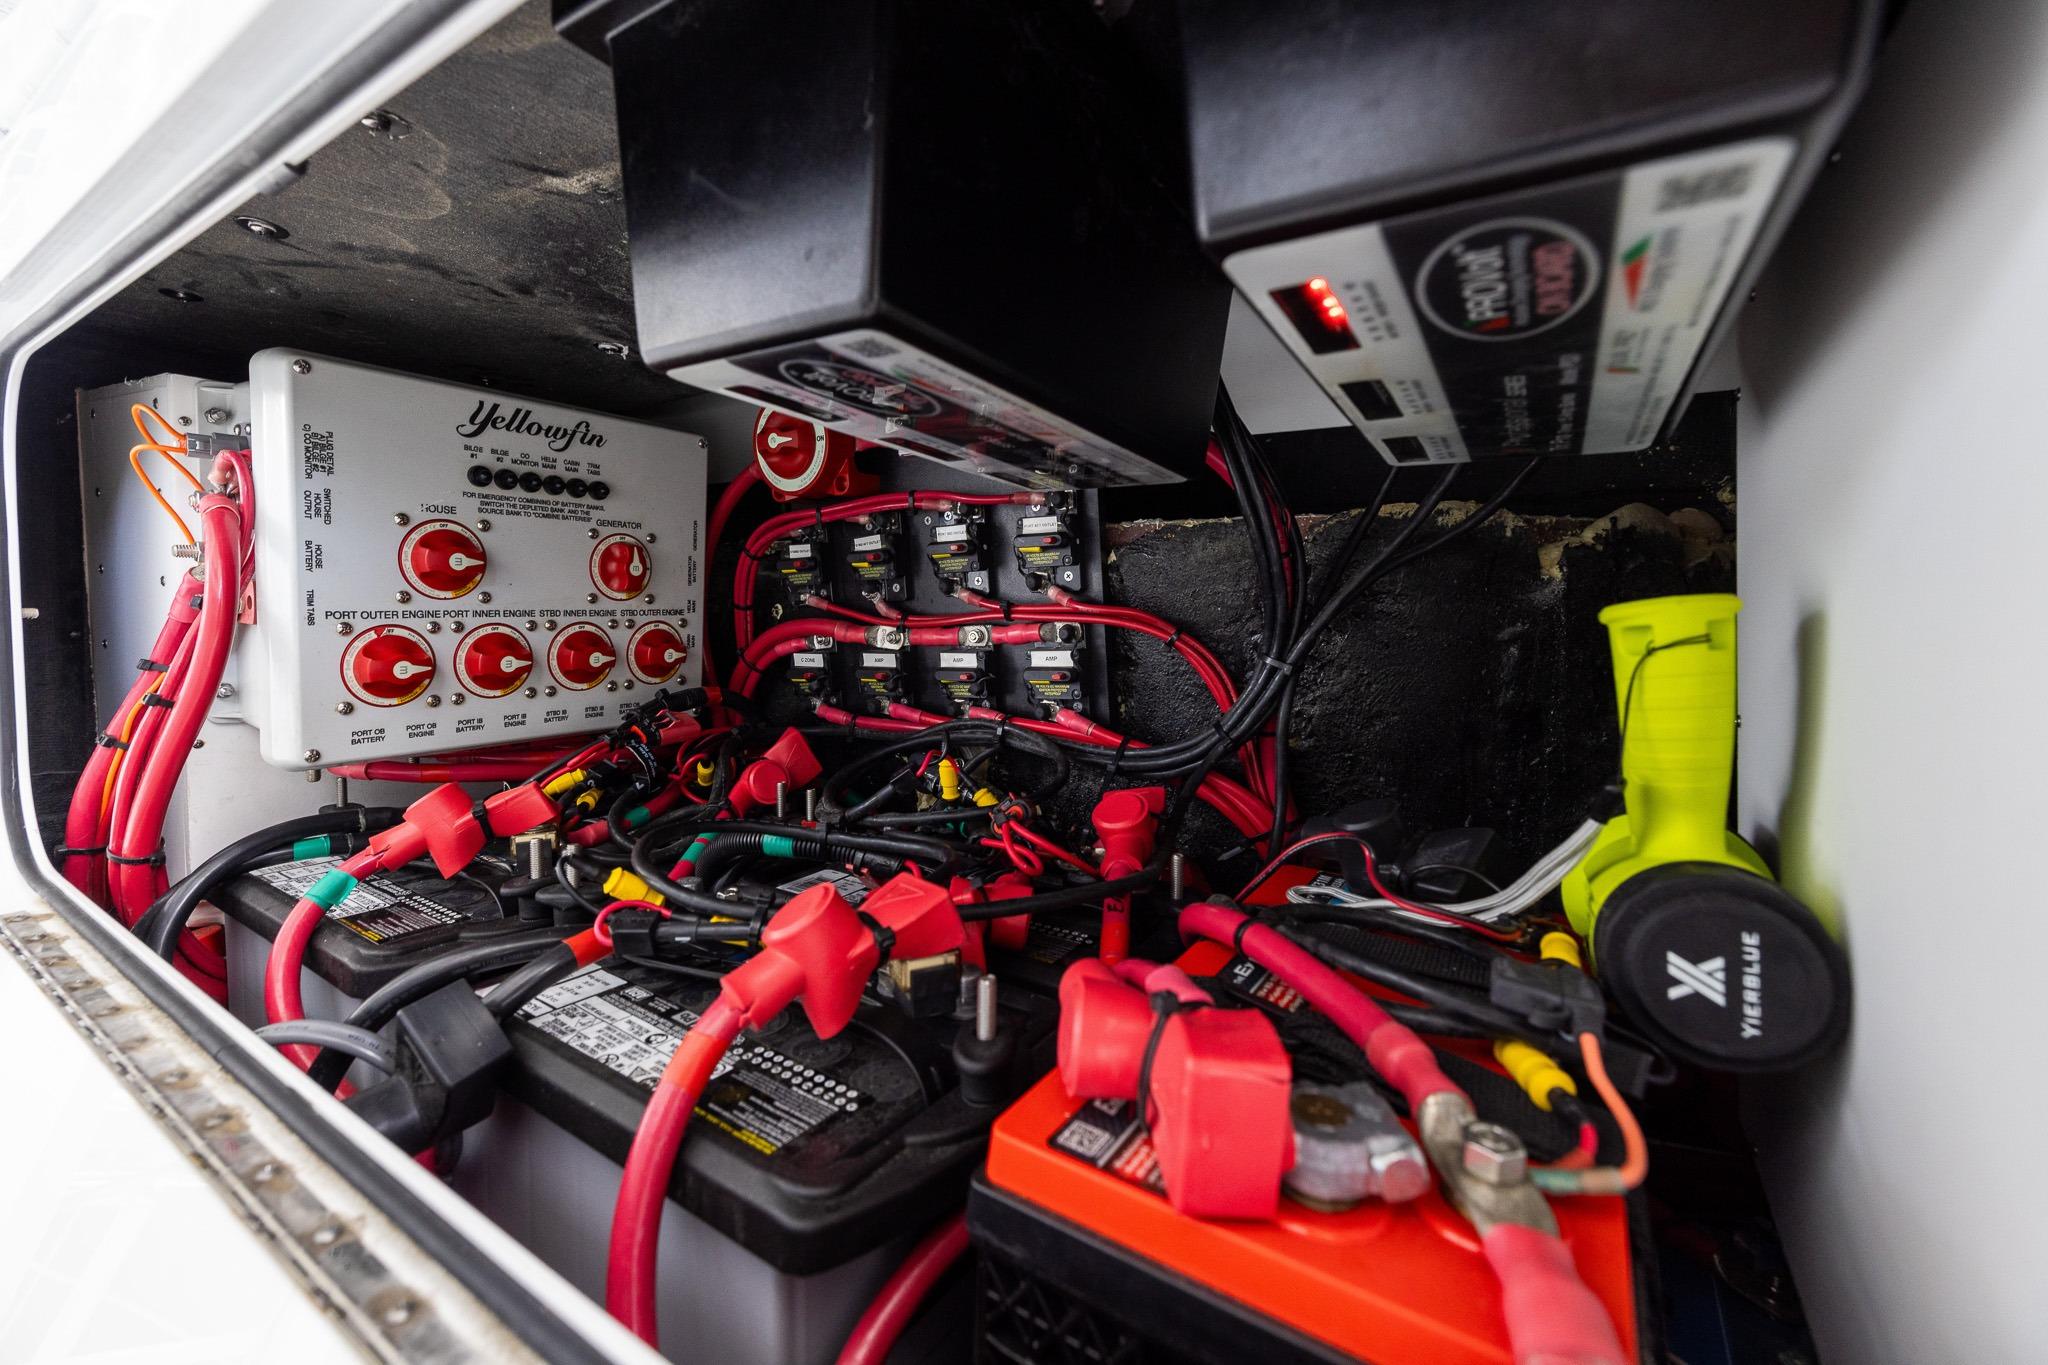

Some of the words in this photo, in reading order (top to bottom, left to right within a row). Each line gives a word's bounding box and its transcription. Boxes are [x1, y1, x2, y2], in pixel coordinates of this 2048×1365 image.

[456, 400, 607, 452] Yellowfin
[303, 433, 311, 445] CO
[326, 431, 334, 451] PLUG
[311, 442, 320, 463] BILGE
[319, 443, 327, 464] BILGE
[463, 444, 483, 454] BILGE
[490, 448, 509, 457] BILGE
[304, 446, 313, 480] MONITOR
[326, 452, 335, 477] DETAIL
[511, 459, 539, 468] MONITOR
[541, 462, 557, 470] MAIN
[563, 459, 580, 467] CABIN
[304, 490, 312, 520] OUTPUT
[314, 493, 322, 518] HOUSE
[463, 491, 477, 499] FOR
[478, 493, 517, 503] EMERGENCY
[518, 496, 551, 506] COMBINING
[561, 501, 586, 510] BATTERY
[323, 488, 332, 525] SWITCHED
[478, 507, 504, 515] SOURCE
[505, 509, 522, 517] BANK
[480, 501, 505, 510] SWITCH
[519, 504, 550, 513] DEPLETED
[596, 519, 642, 530] GENERATOR
[305, 540, 313, 573] BATTERY
[315, 544, 323, 569] HOUSE
[306, 589, 314, 607] TRIM
[307, 608, 315, 626] TABS
[325, 610, 358, 620] PORT
[360, 610, 399, 620] OUTER
[401, 610, 441, 619] ENGINE
[442, 610, 470, 619] PORT
[472, 610, 501, 618] INNER
[503, 610, 536, 618] ENGINE
[539, 609, 561, 618] STBD
[563, 609, 587, 617] INNER
[589, 609, 617, 617] ENGINE
[620, 609, 638, 617] STBD
[639, 609, 662, 617] OUTER
[662, 609, 685, 617] ENGINE
[406, 724, 425, 732] PORT
[427, 722, 437, 730] OB
[457, 718, 475, 726] PORT
[504, 720, 526, 728] ENGINE
[351, 729, 372, 738] PORT
[374, 728, 386, 736] OB
[409, 730, 435, 739] ENGINE
[455, 725, 485, 733] BATTERY
[351, 735, 386, 745] BATTERY
[1741, 931, 1763, 1039] YIERBLUE
